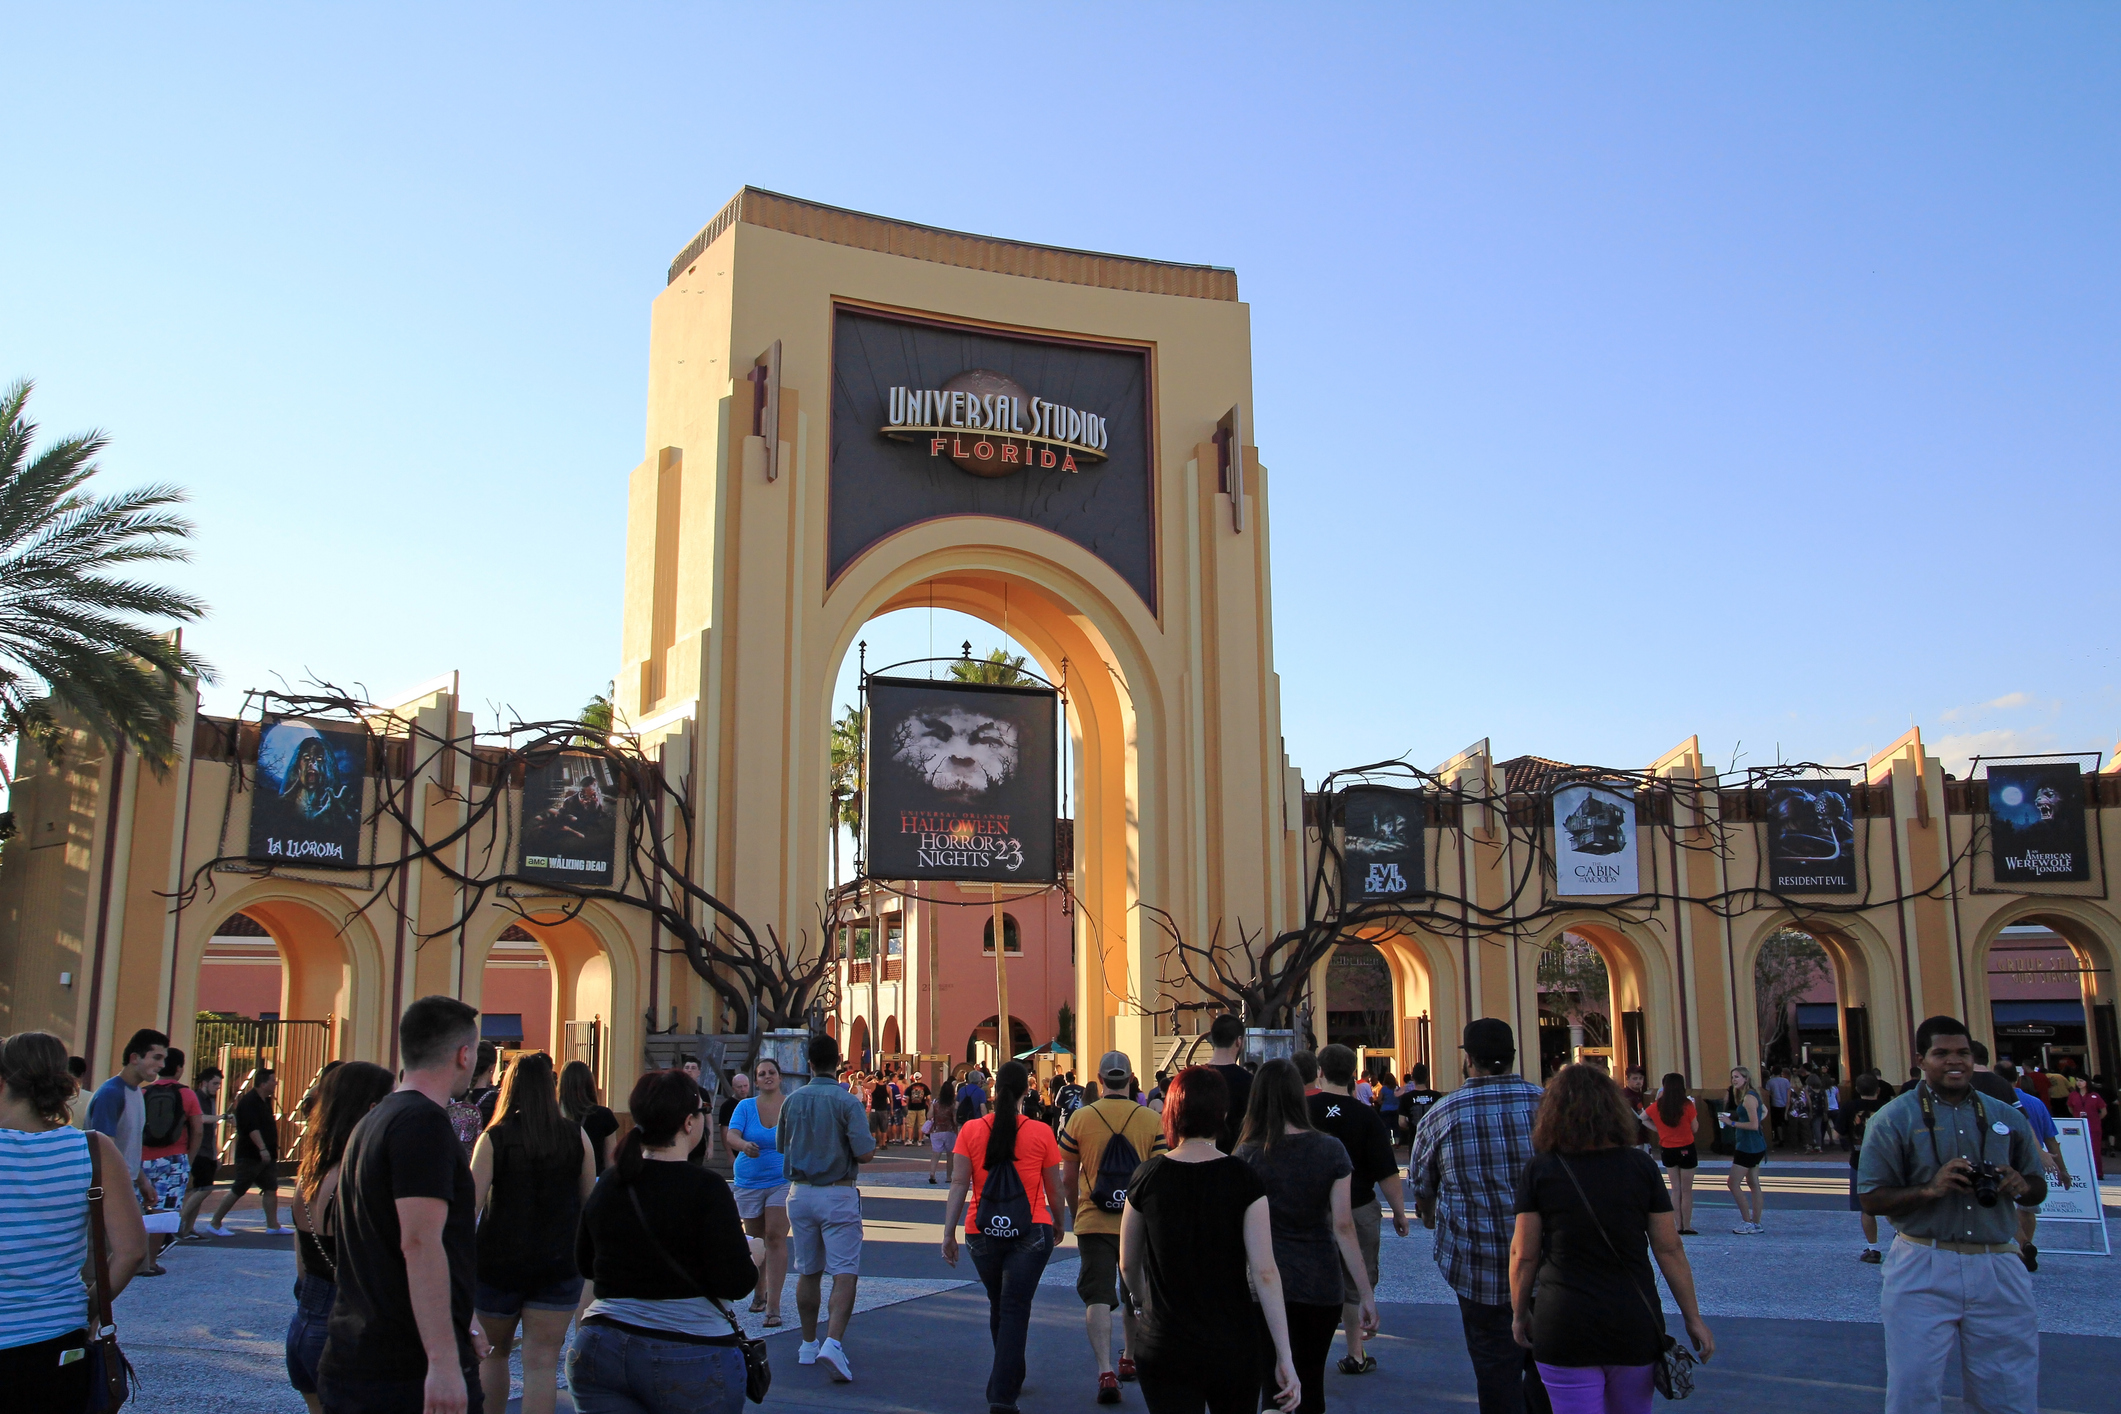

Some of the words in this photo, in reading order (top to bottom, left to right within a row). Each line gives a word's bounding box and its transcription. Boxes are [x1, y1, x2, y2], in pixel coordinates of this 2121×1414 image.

[888, 386, 1024, 434] UNIVERSAL
[1027, 396, 1108, 450] STUDIOS
[930, 438, 1078, 473] FLORIDA
[900, 810, 958, 818] UNIVERSAL
[900, 816, 1009, 835] HALLOWEEN
[267, 837, 283, 856] LA
[286, 839, 344, 860] LLORONA
[919, 833, 997, 851] HORROR
[917, 850, 990, 868] NIGHTS
[995, 837, 1025, 872] 23
[2026, 849, 2072, 860] AMERICAN
[549, 857, 585, 871] WALKING
[585, 860, 607, 872] DEAD
[2005, 856, 2072, 870] WEREWOLF
[1370, 864, 1401, 878] EVIL
[1574, 865, 1620, 877] CABIN
[2036, 866, 2072, 876] LONDON
[1365, 876, 1407, 892] DEAD
[1778, 876, 1825, 886] RESIDENT
[1825, 876, 1847, 886] EVIL
[1997, 959, 2042, 970] GROUP
[1105, 1200, 1125, 1209] car
[984, 1227, 1019, 1238] caron
